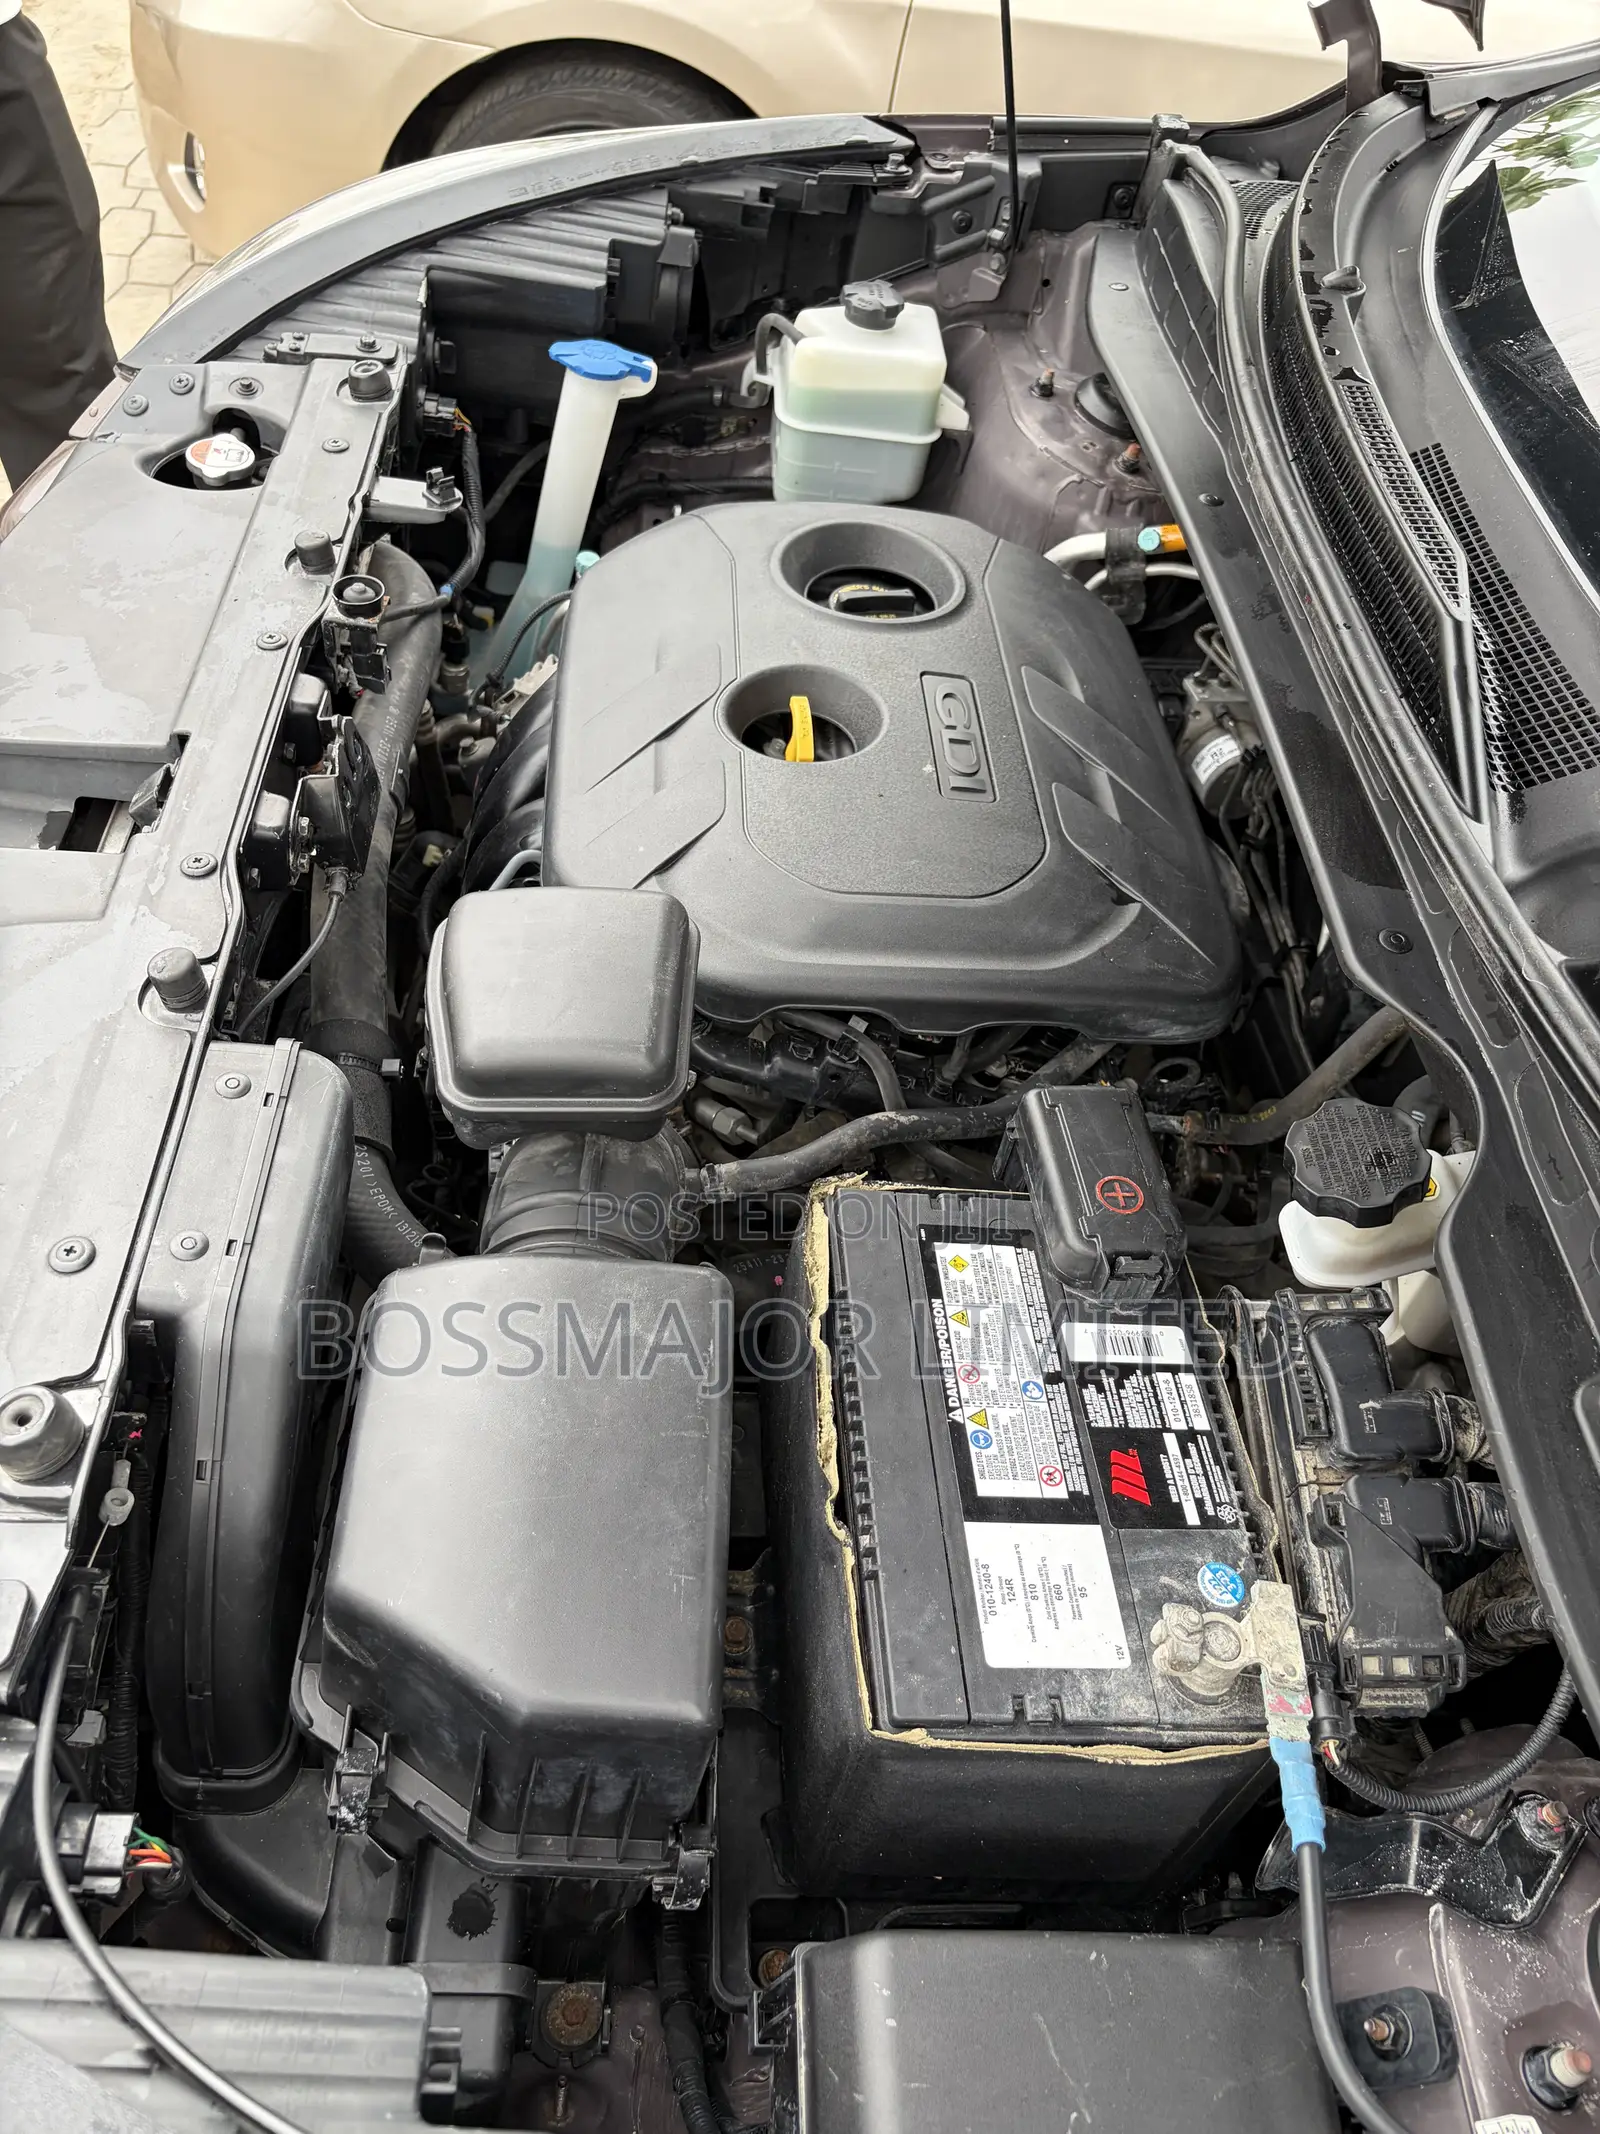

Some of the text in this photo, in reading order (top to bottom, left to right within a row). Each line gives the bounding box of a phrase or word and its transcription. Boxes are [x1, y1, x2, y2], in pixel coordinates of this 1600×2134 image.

[934, 682, 987, 794] GDI
[930, 1298, 960, 1406] DANGER/POISON
[1161, 1378, 1181, 1422] 010-1240-8
[1184, 1383, 1202, 1418] 3831858
[1159, 1453, 1173, 1478] BOOST?
[1171, 1453, 1191, 1501] 1-800-444-4597
[1168, 1485, 1179, 1502] NEED
[980, 1563, 997, 1615] 010-1240-8
[1004, 1578, 1016, 1602] 124R
[1027, 1583, 1039, 1600] 810
[1052, 1583, 1063, 1600] 660
[1077, 1586, 1088, 1597] 95
[1114, 1644, 1125, 1659] 12V
